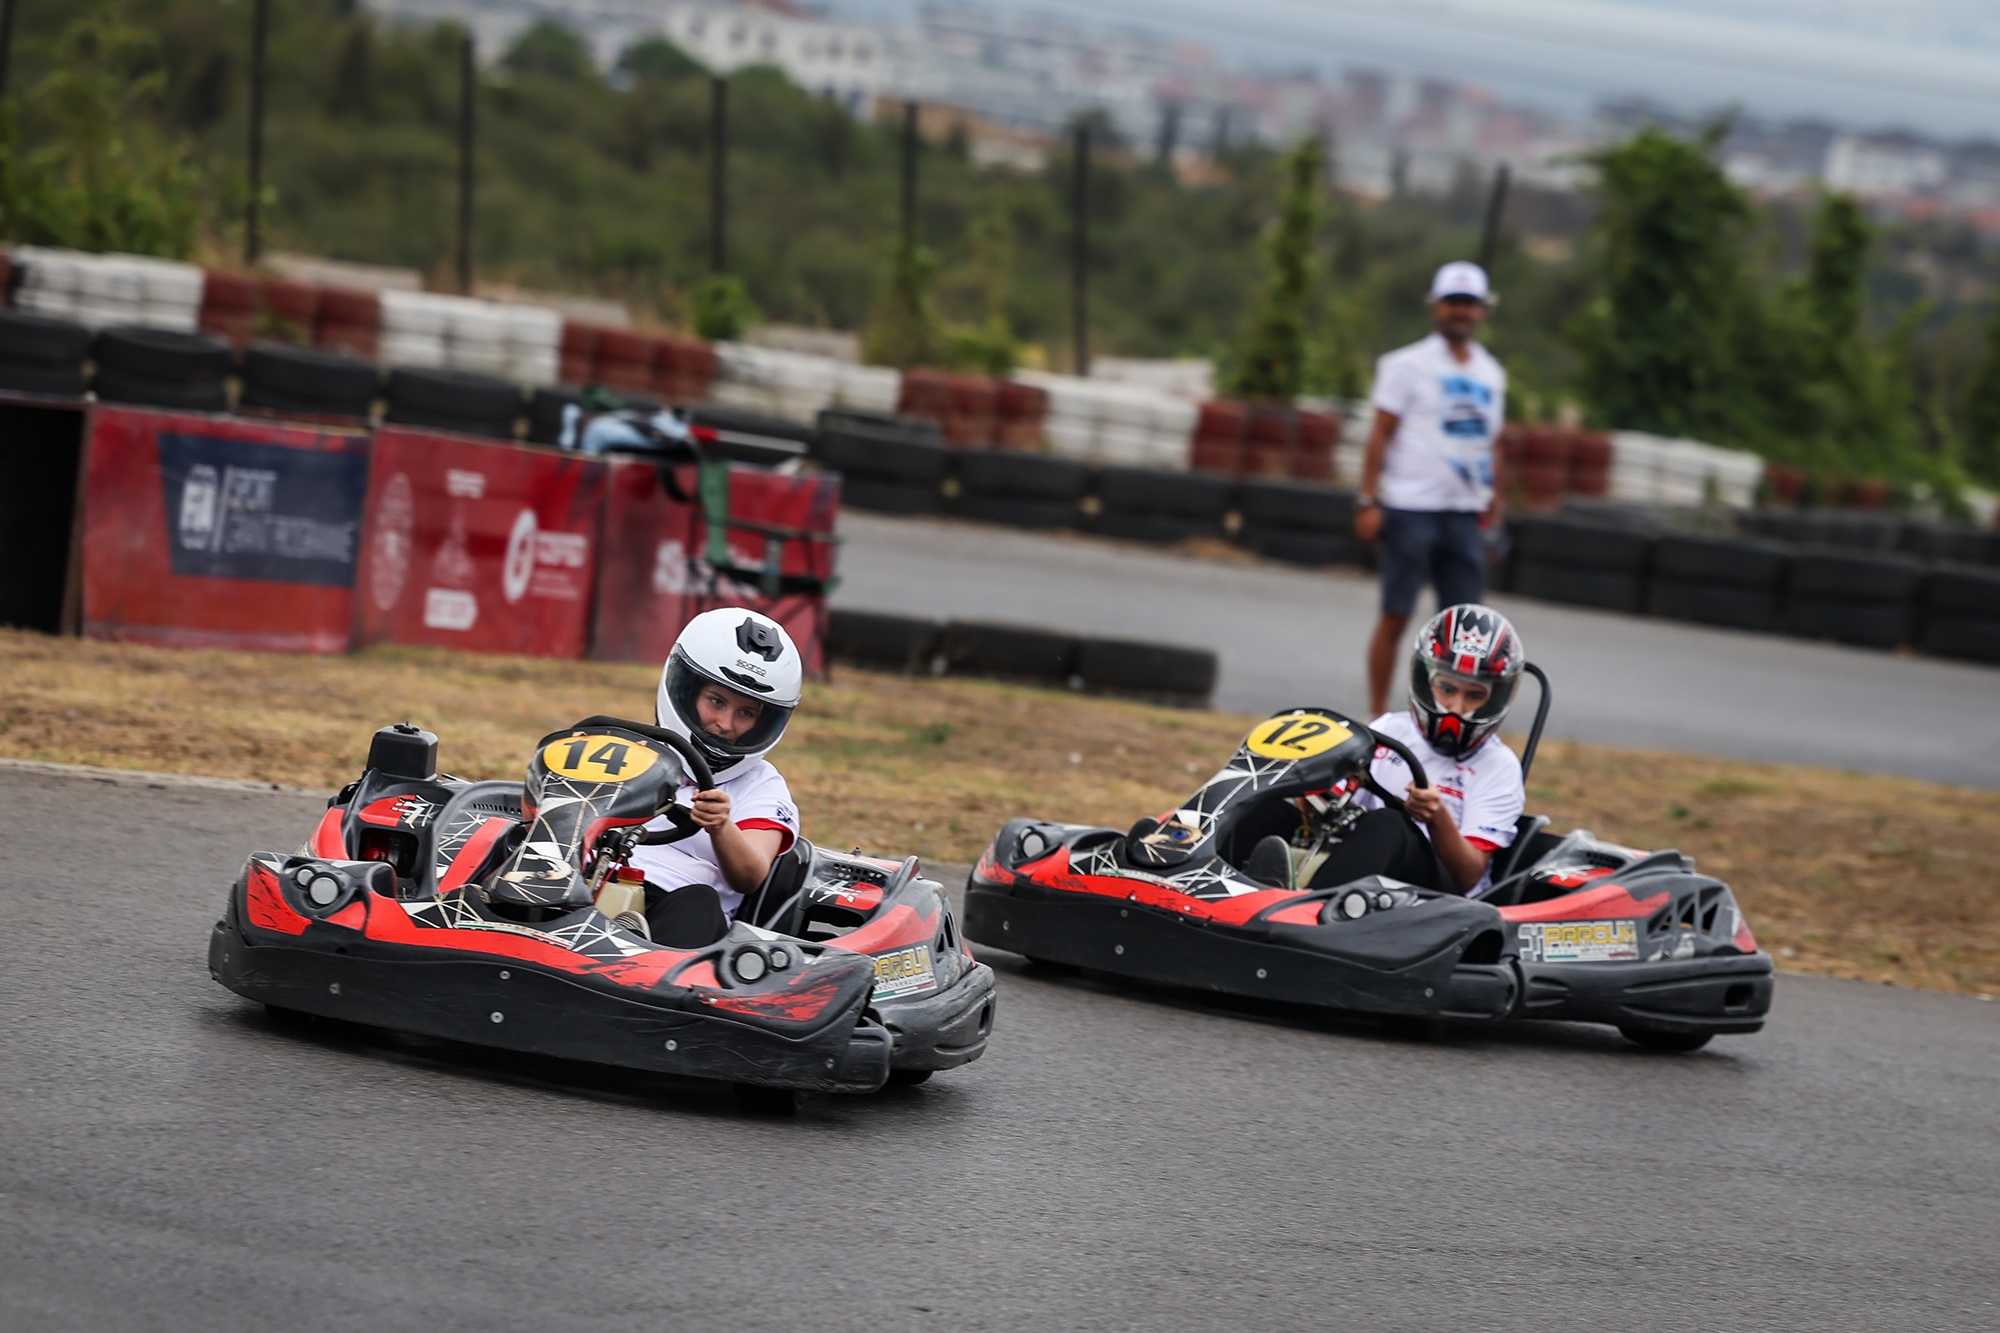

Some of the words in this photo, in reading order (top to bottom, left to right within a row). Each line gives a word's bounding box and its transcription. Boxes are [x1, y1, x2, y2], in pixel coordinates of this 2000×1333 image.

[736, 659, 767, 677] sparco
[1262, 719, 1330, 752] 12
[563, 740, 630, 776] 14
